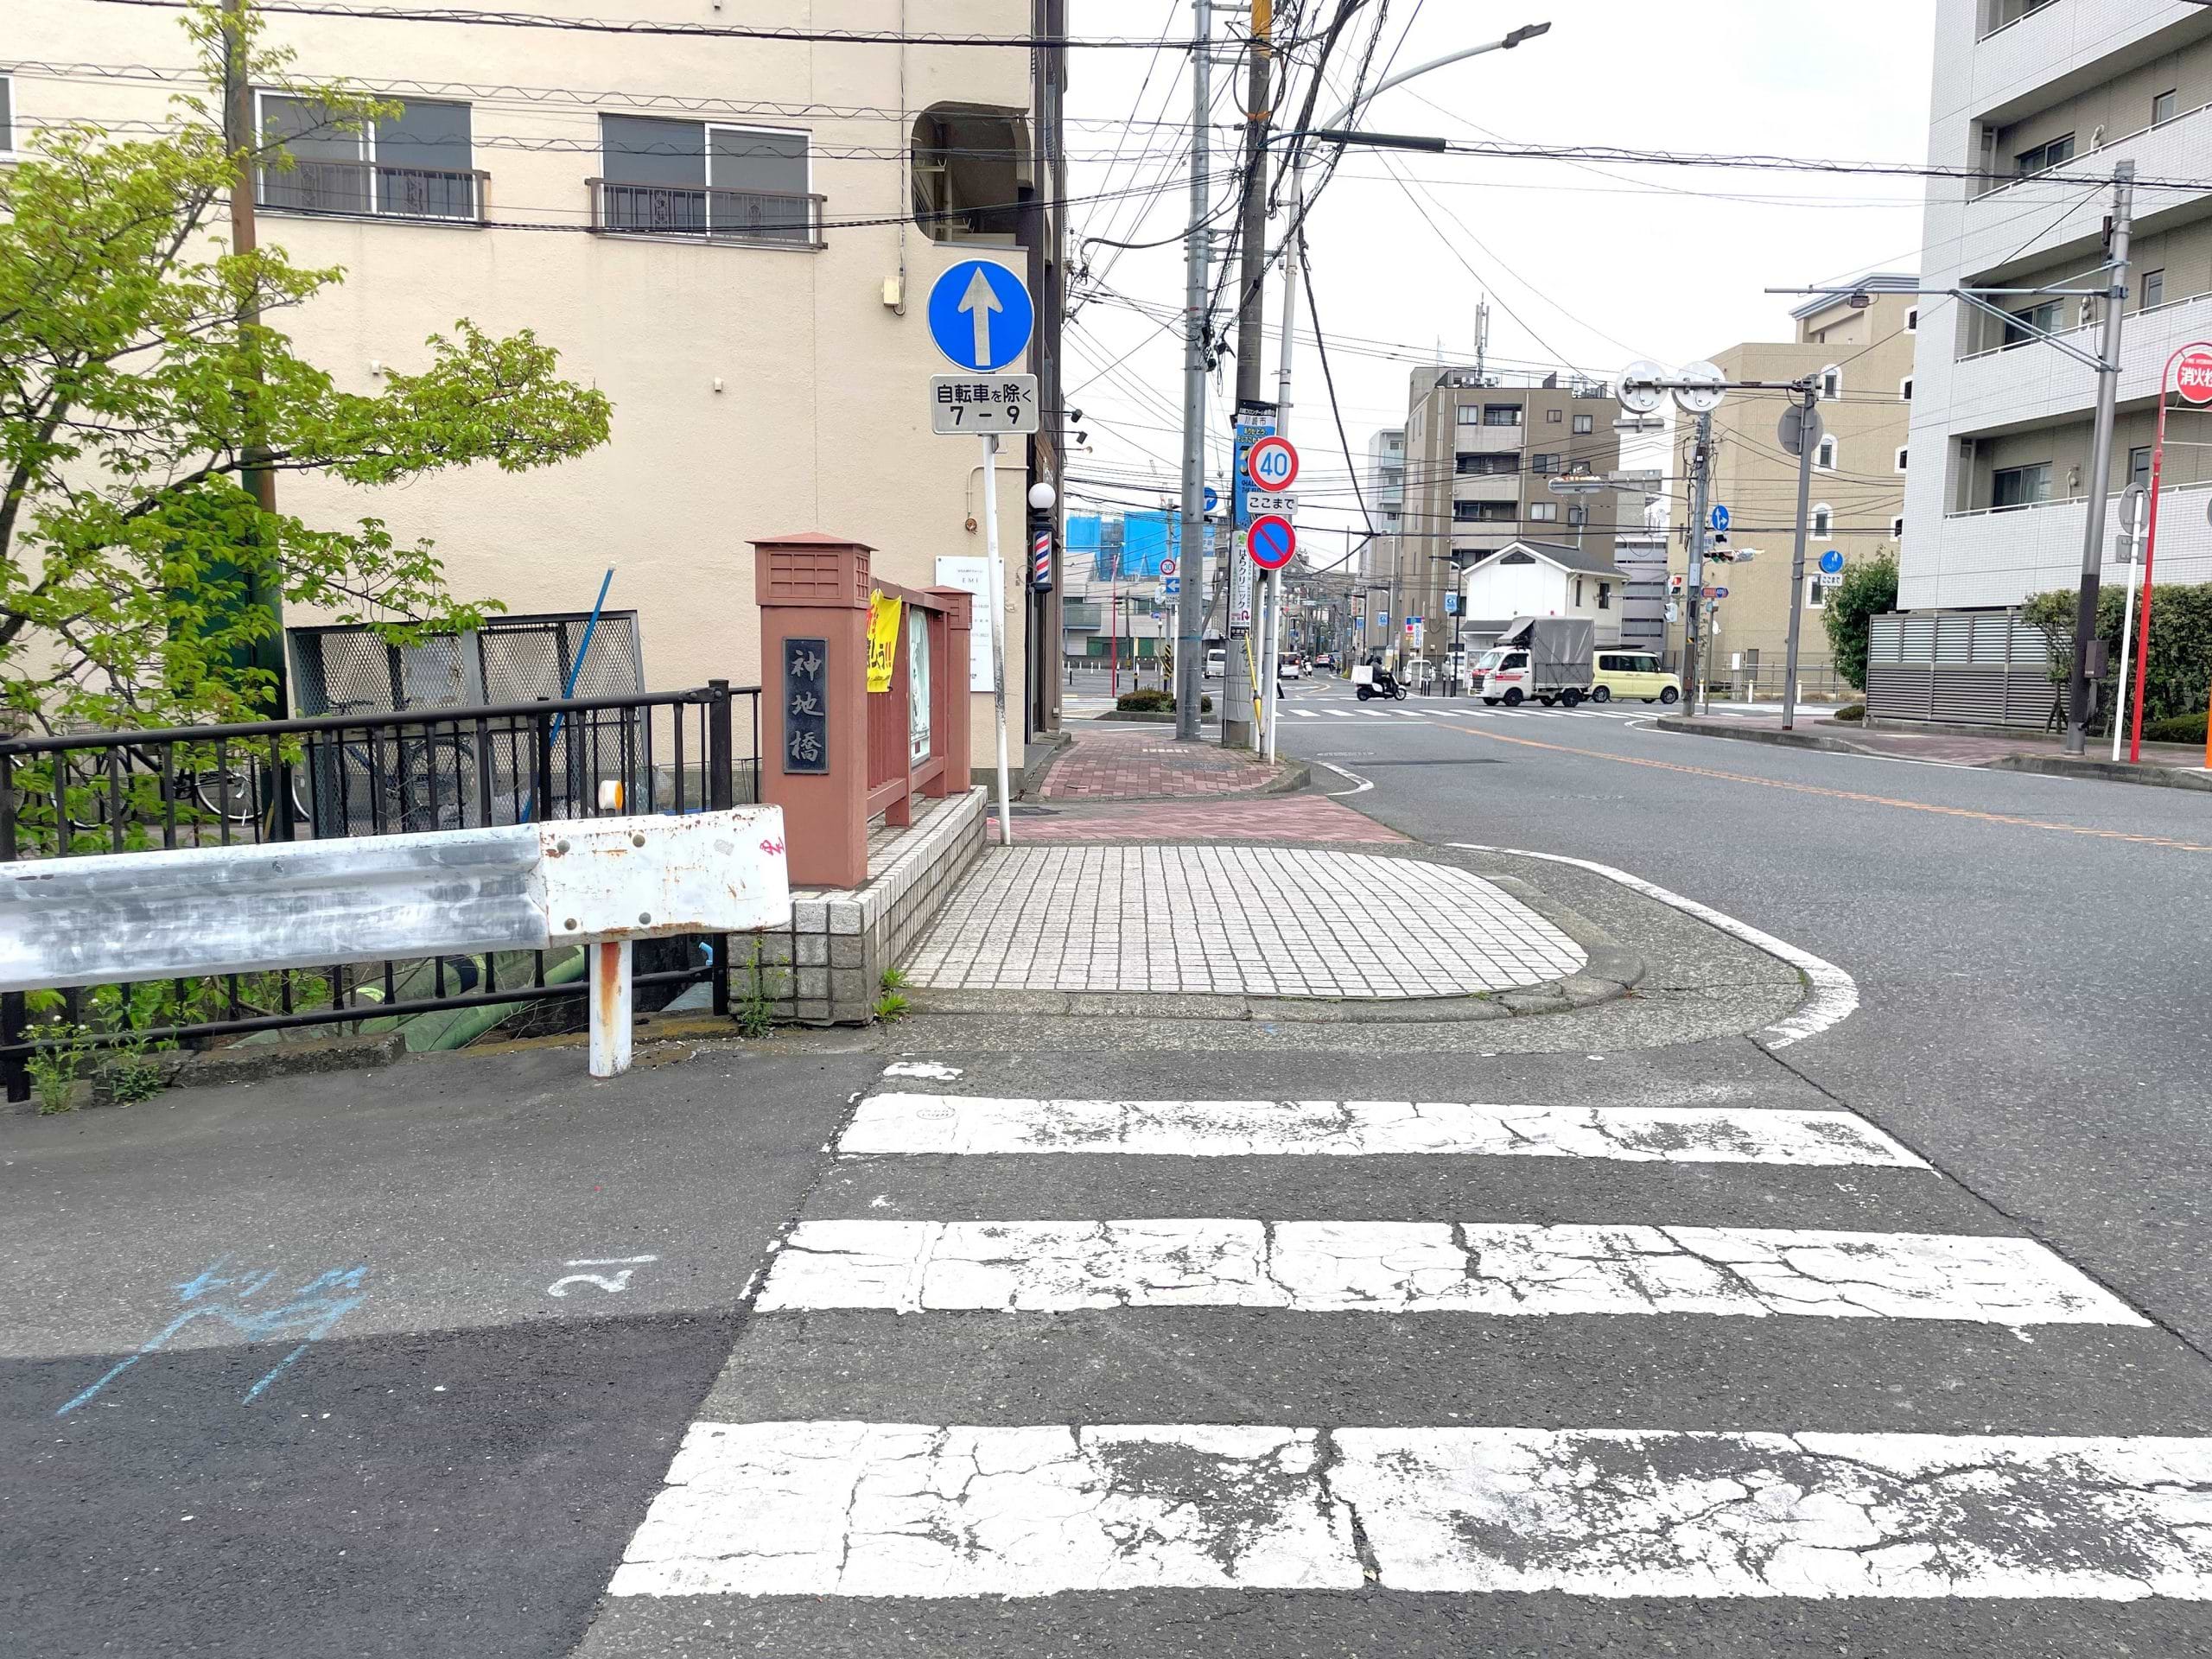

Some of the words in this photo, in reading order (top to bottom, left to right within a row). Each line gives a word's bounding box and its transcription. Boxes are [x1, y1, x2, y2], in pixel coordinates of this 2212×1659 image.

[938, 384, 1032, 404] 自転車を除く
[1260, 452, 1287, 476] 40
[1249, 497, 1295, 510] ここまで
[1238, 549, 1247, 609] はらクリニック
[790, 649, 824, 762] 神地橋
